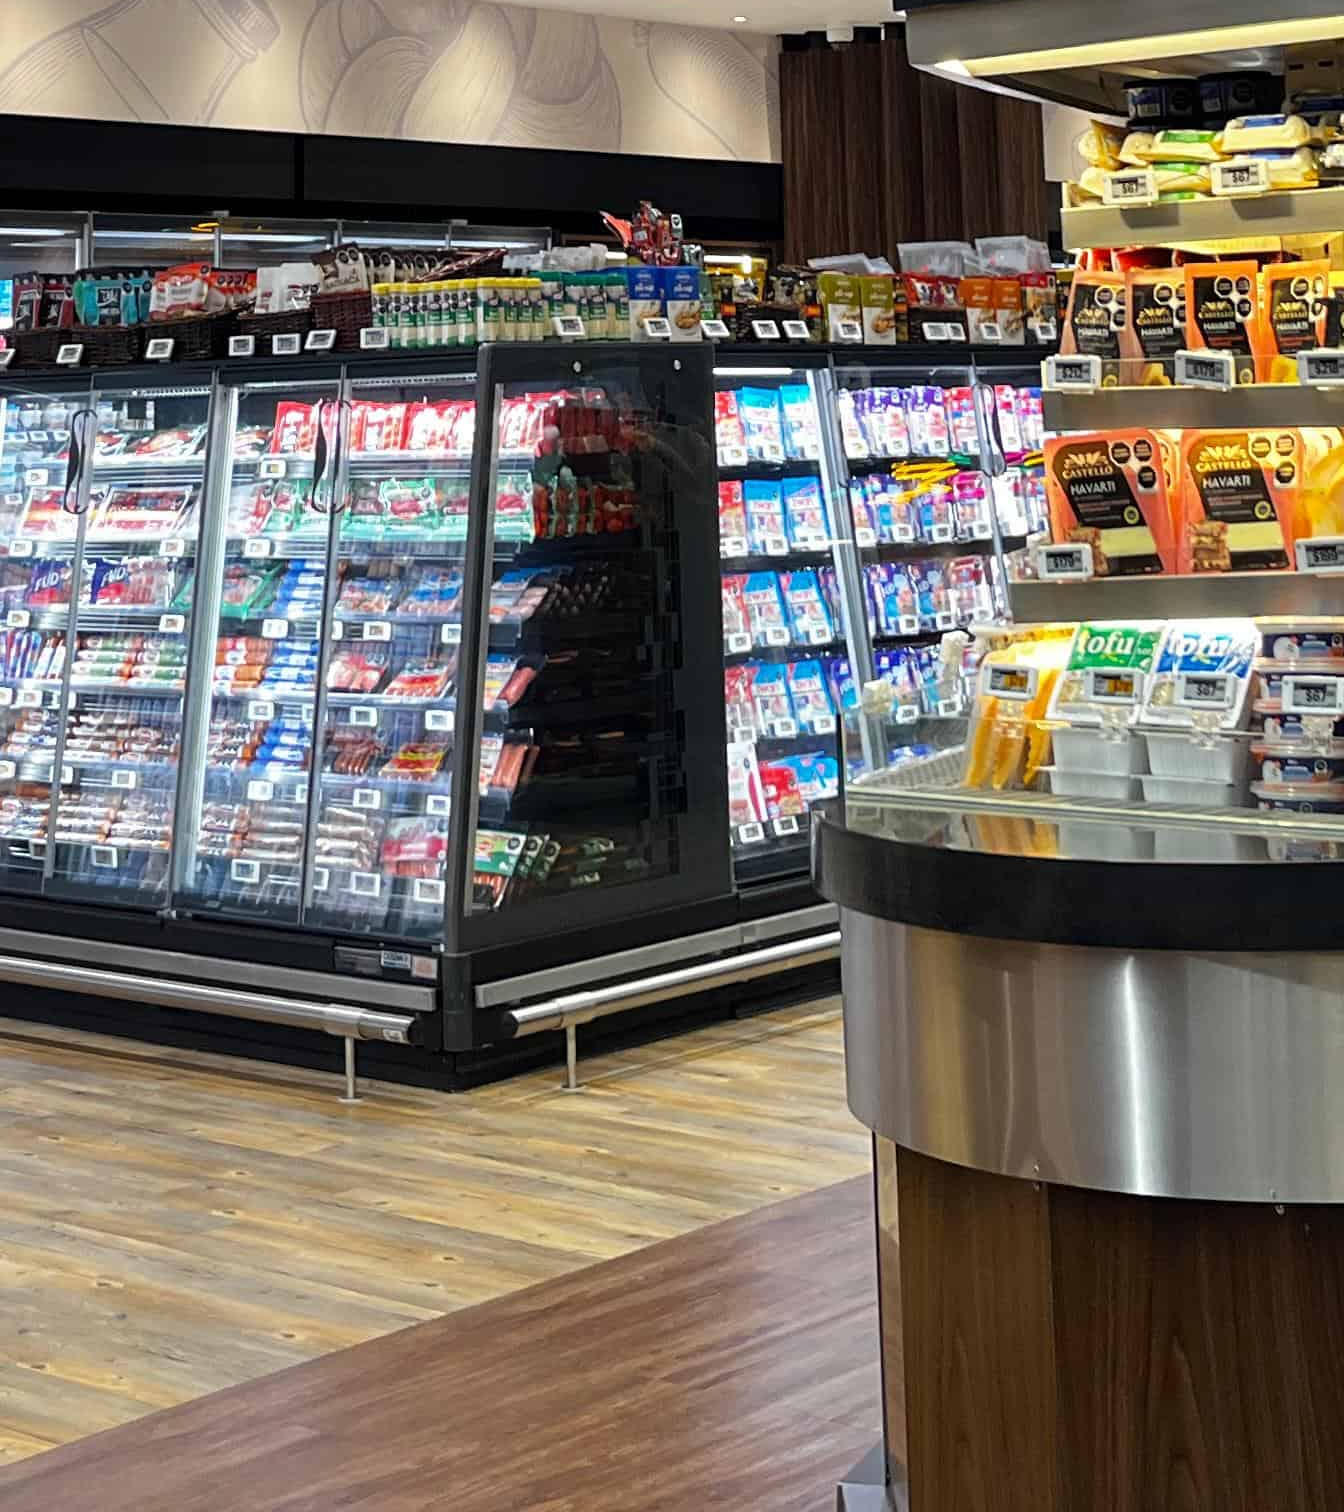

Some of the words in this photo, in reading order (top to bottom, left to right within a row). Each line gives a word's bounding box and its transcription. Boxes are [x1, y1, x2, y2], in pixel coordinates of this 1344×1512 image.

[1069, 480, 1116, 496] HAVARTI
[1202, 474, 1251, 489] HAVARTI
[1079, 628, 1134, 656] tofu
